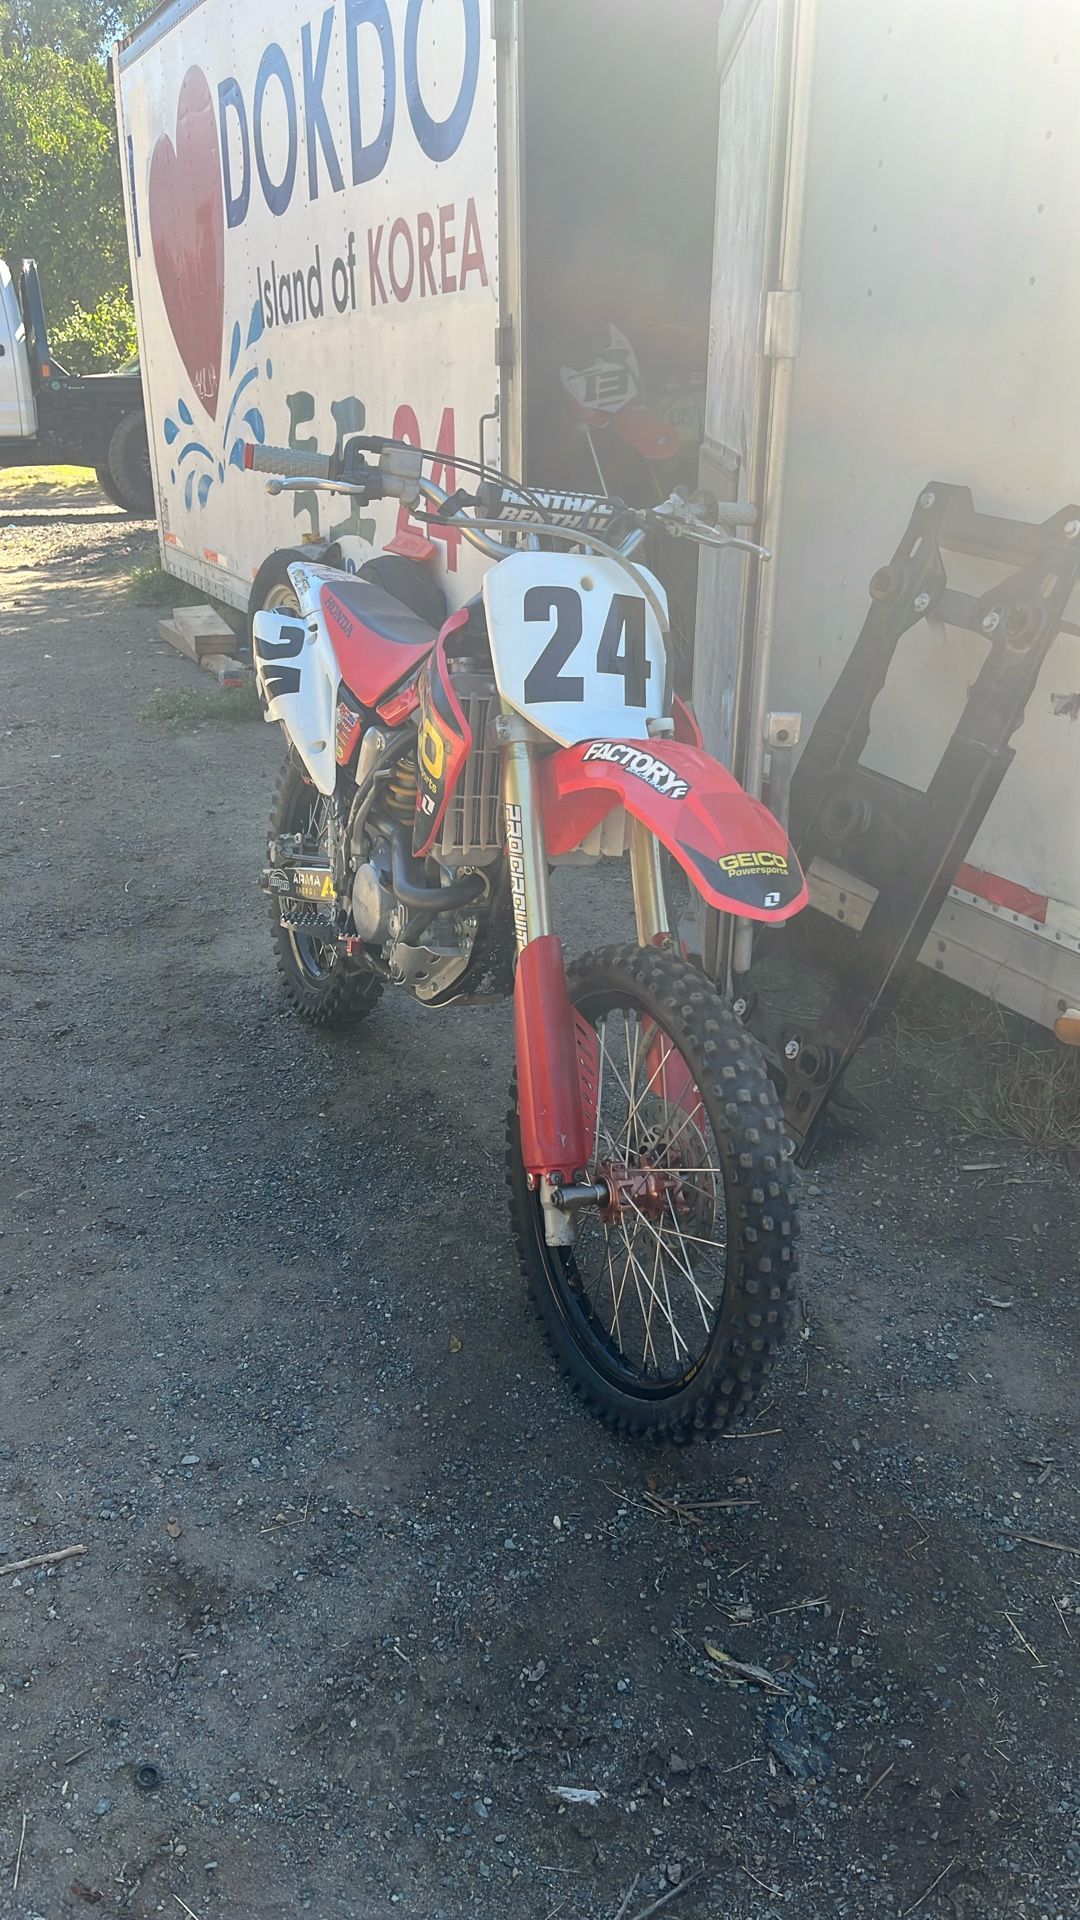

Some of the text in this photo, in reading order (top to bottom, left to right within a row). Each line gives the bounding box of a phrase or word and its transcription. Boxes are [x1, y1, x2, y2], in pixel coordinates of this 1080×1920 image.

[218, 0, 480, 229] DOKDO
[257, 197, 489, 328] Island of KOREA
[325, 596, 353, 638] HONDA
[523, 586, 651, 708] 24
[583, 743, 688, 793] FACTORY
[293, 873, 321, 887] ARMA
[718, 852, 788, 871] GEICO
[728, 867, 789, 878] Powersports
